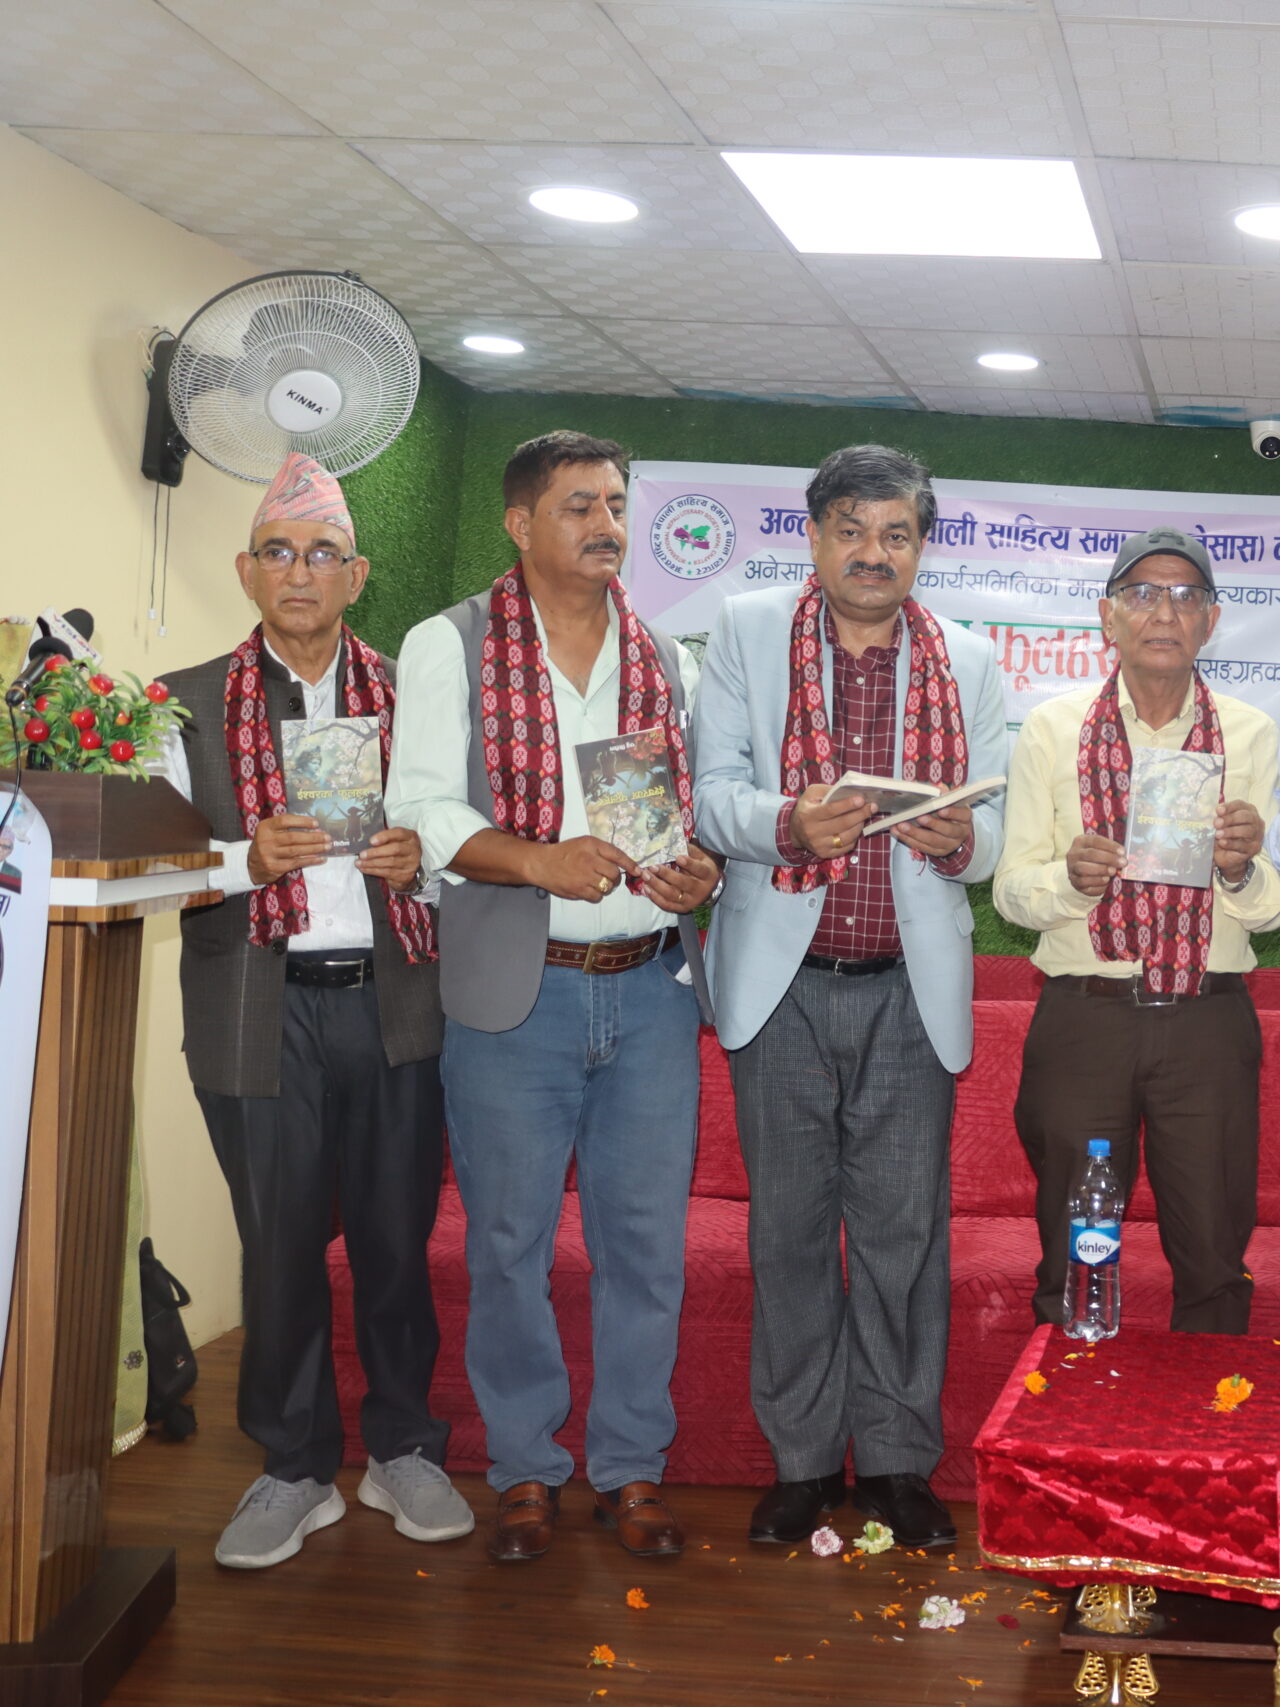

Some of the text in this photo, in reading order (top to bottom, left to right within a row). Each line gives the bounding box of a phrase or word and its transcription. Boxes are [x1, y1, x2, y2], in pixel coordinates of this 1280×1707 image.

[286, 389, 323, 415] KINMA
[654, 503, 675, 530] नेपाली
[675, 496, 708, 507] साहित्य
[709, 502, 730, 525] समाज
[722, 530, 735, 557] नेपाल
[985, 514, 1072, 552] साहित्य
[1079, 527, 1146, 554] समा
[917, 565, 1060, 595] कार्यसमितिका
[1077, 1240, 1112, 1255] kinley
